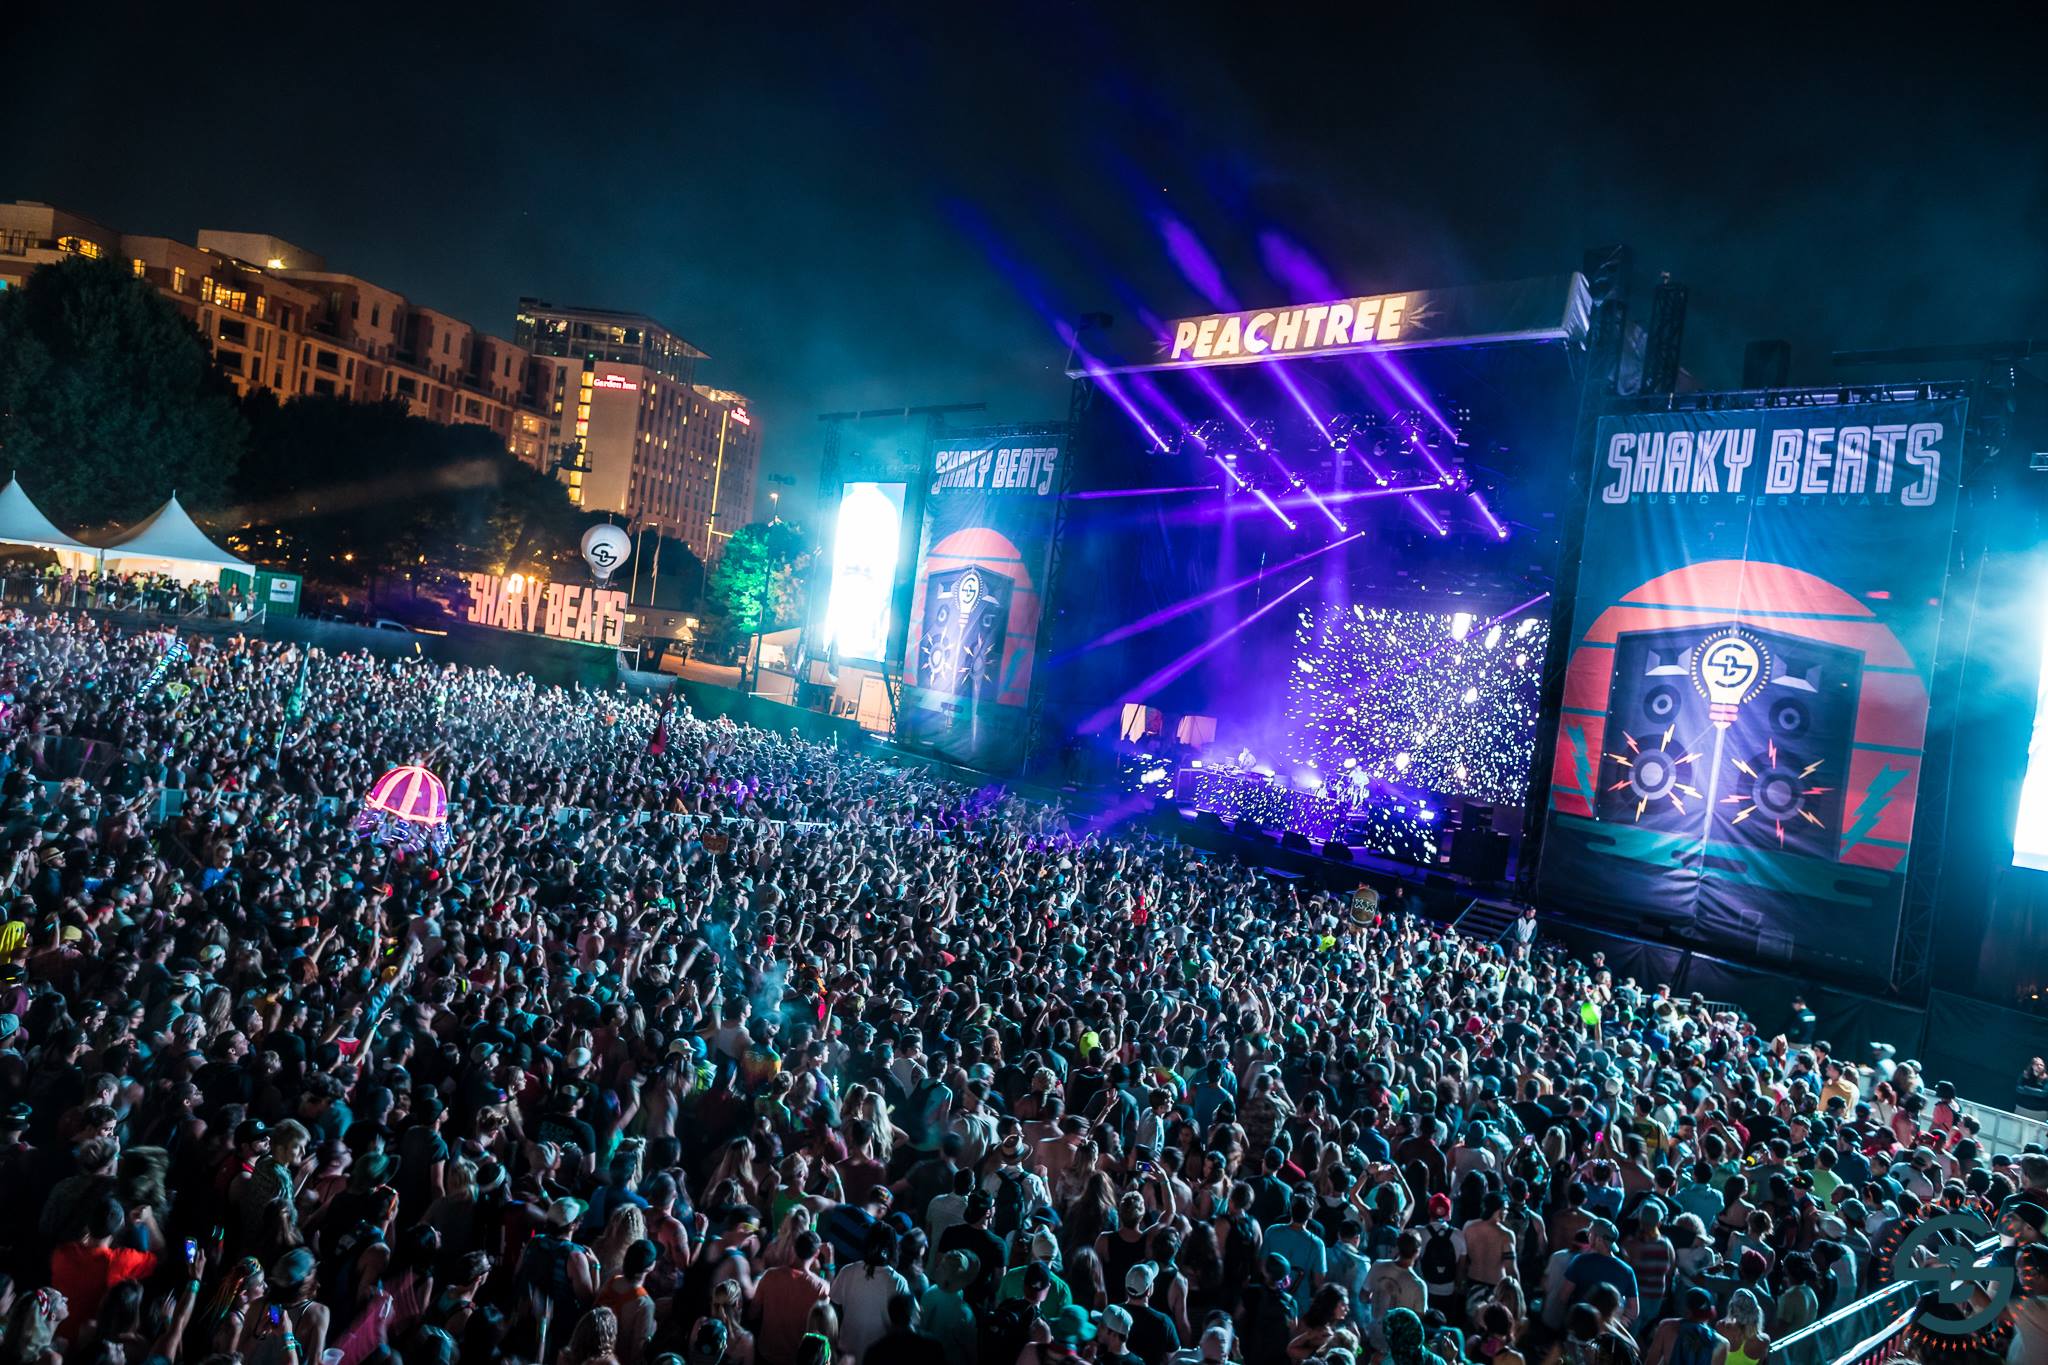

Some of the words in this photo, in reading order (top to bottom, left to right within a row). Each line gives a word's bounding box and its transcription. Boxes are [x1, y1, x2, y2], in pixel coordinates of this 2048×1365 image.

[1171, 296, 1408, 359] PEACHTREE
[931, 450, 994, 495] SHAKY
[992, 447, 1058, 496] BEATS
[1602, 428, 1757, 504] SHAKY
[1765, 422, 1944, 507] BEATS
[1630, 494, 1710, 505] MUSIC
[1735, 495, 1895, 507] FESTIVAL
[467, 573, 543, 633] SHAKY
[545, 582, 629, 646] BEATS
